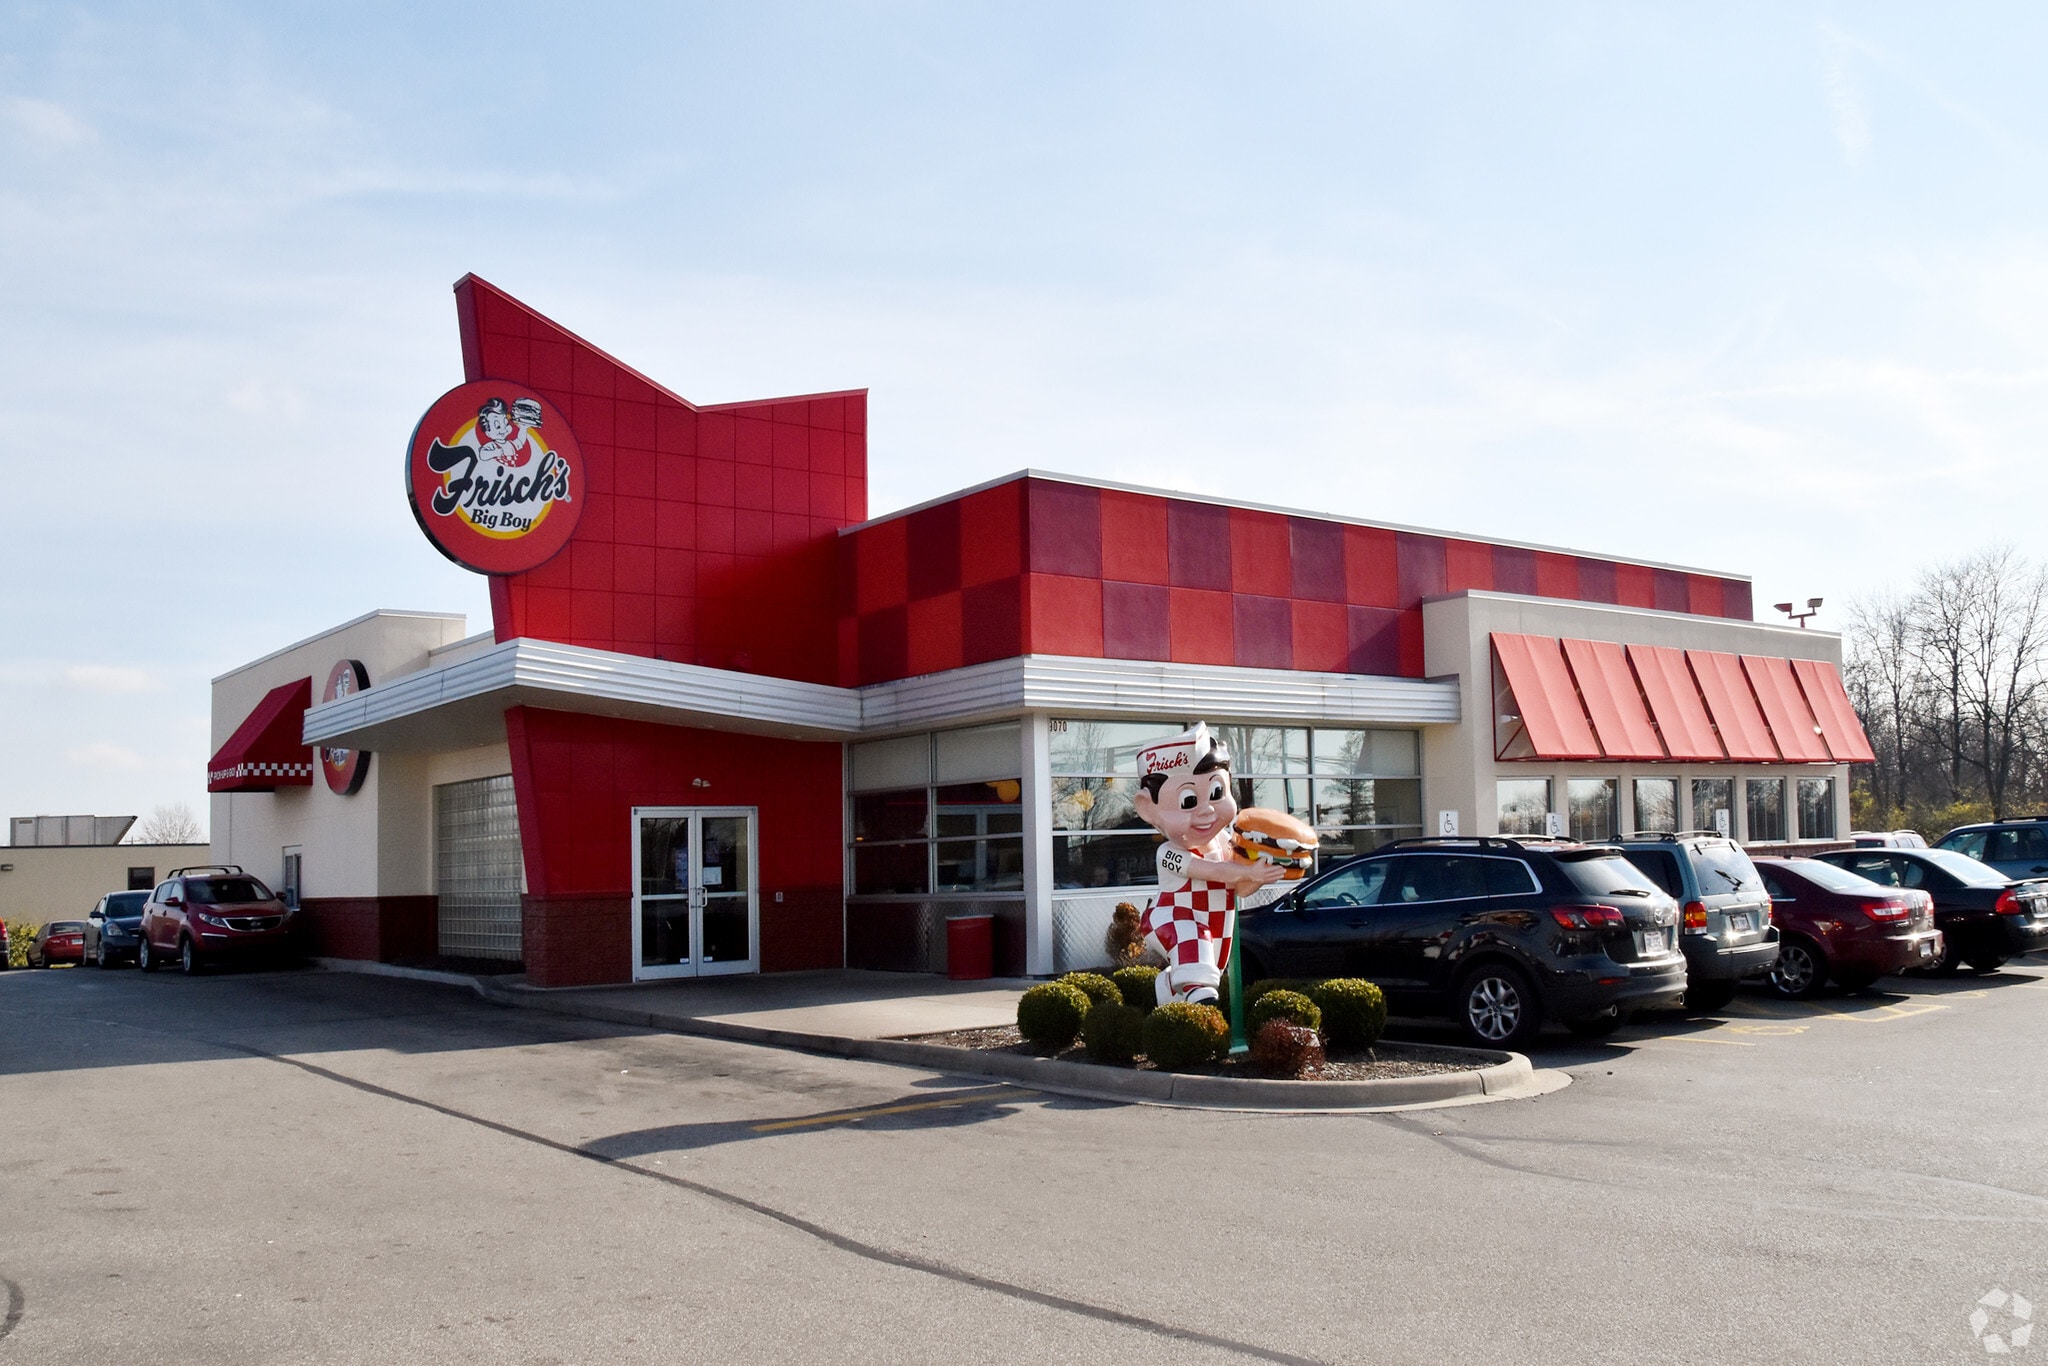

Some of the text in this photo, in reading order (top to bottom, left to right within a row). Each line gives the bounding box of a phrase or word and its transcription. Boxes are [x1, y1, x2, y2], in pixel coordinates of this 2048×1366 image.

[427, 437, 570, 516] Frisch's
[470, 508, 532, 533] Big Boy
[1145, 751, 1189, 775] Frisch's
[1161, 858, 1182, 874] BOY
[1165, 850, 1183, 864] BIG
